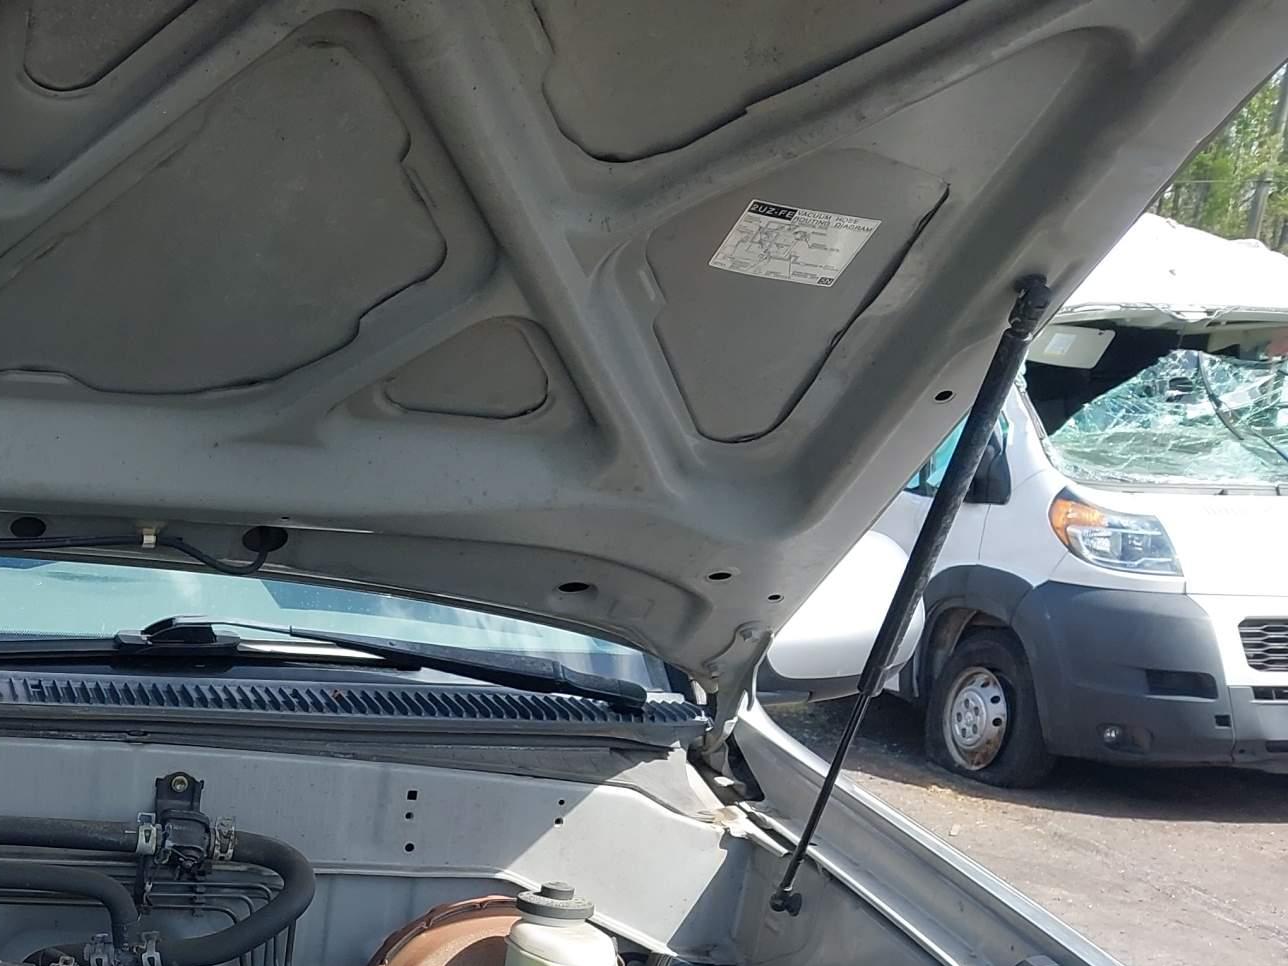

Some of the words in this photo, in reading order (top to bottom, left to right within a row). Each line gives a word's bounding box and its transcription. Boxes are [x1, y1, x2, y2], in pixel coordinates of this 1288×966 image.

[751, 203, 795, 220] 2UZ-FE
[797, 210, 832, 220] VACUUM
[793, 216, 830, 226] ROUTING
[834, 222, 874, 232] DIAGRAM
